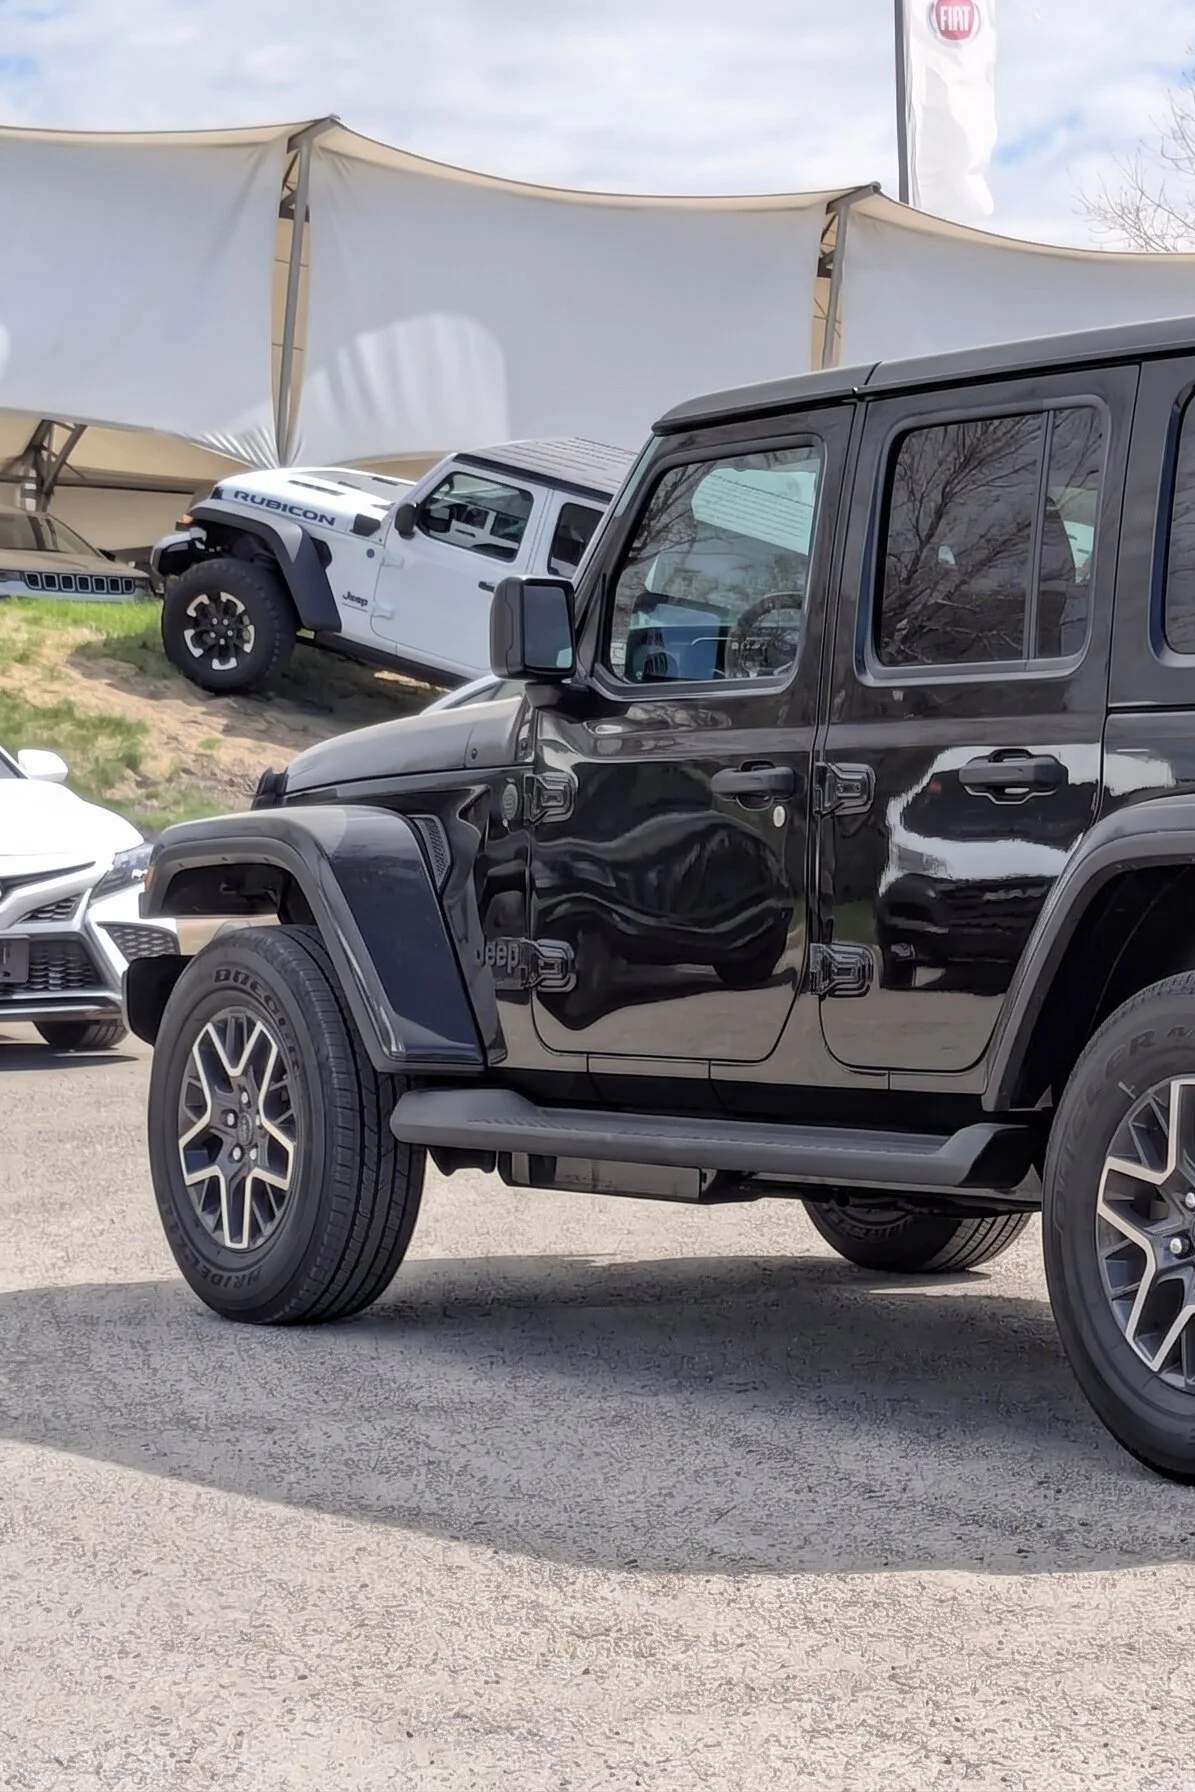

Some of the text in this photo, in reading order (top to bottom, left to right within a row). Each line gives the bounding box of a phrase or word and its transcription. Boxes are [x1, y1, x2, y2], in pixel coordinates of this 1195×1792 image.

[940, 6, 971, 32] FIAT
[234, 489, 336, 526] RUBICON
[342, 591, 368, 608] Jeep
